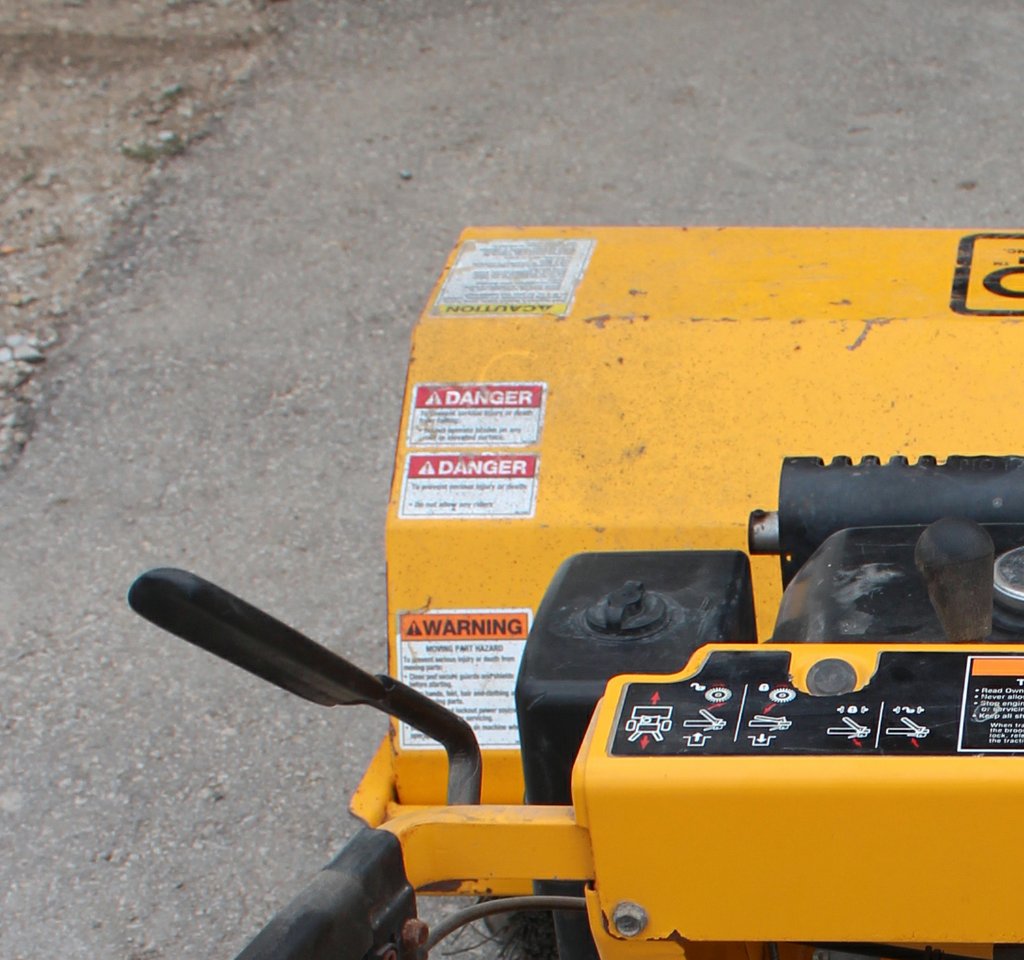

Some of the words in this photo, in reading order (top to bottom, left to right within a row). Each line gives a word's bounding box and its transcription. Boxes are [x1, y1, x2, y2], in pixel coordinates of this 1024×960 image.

[445, 304, 538, 313] CAUTION
[445, 390, 533, 406] DANGER
[437, 460, 528, 475] DANGER
[422, 619, 523, 635] WARNING
